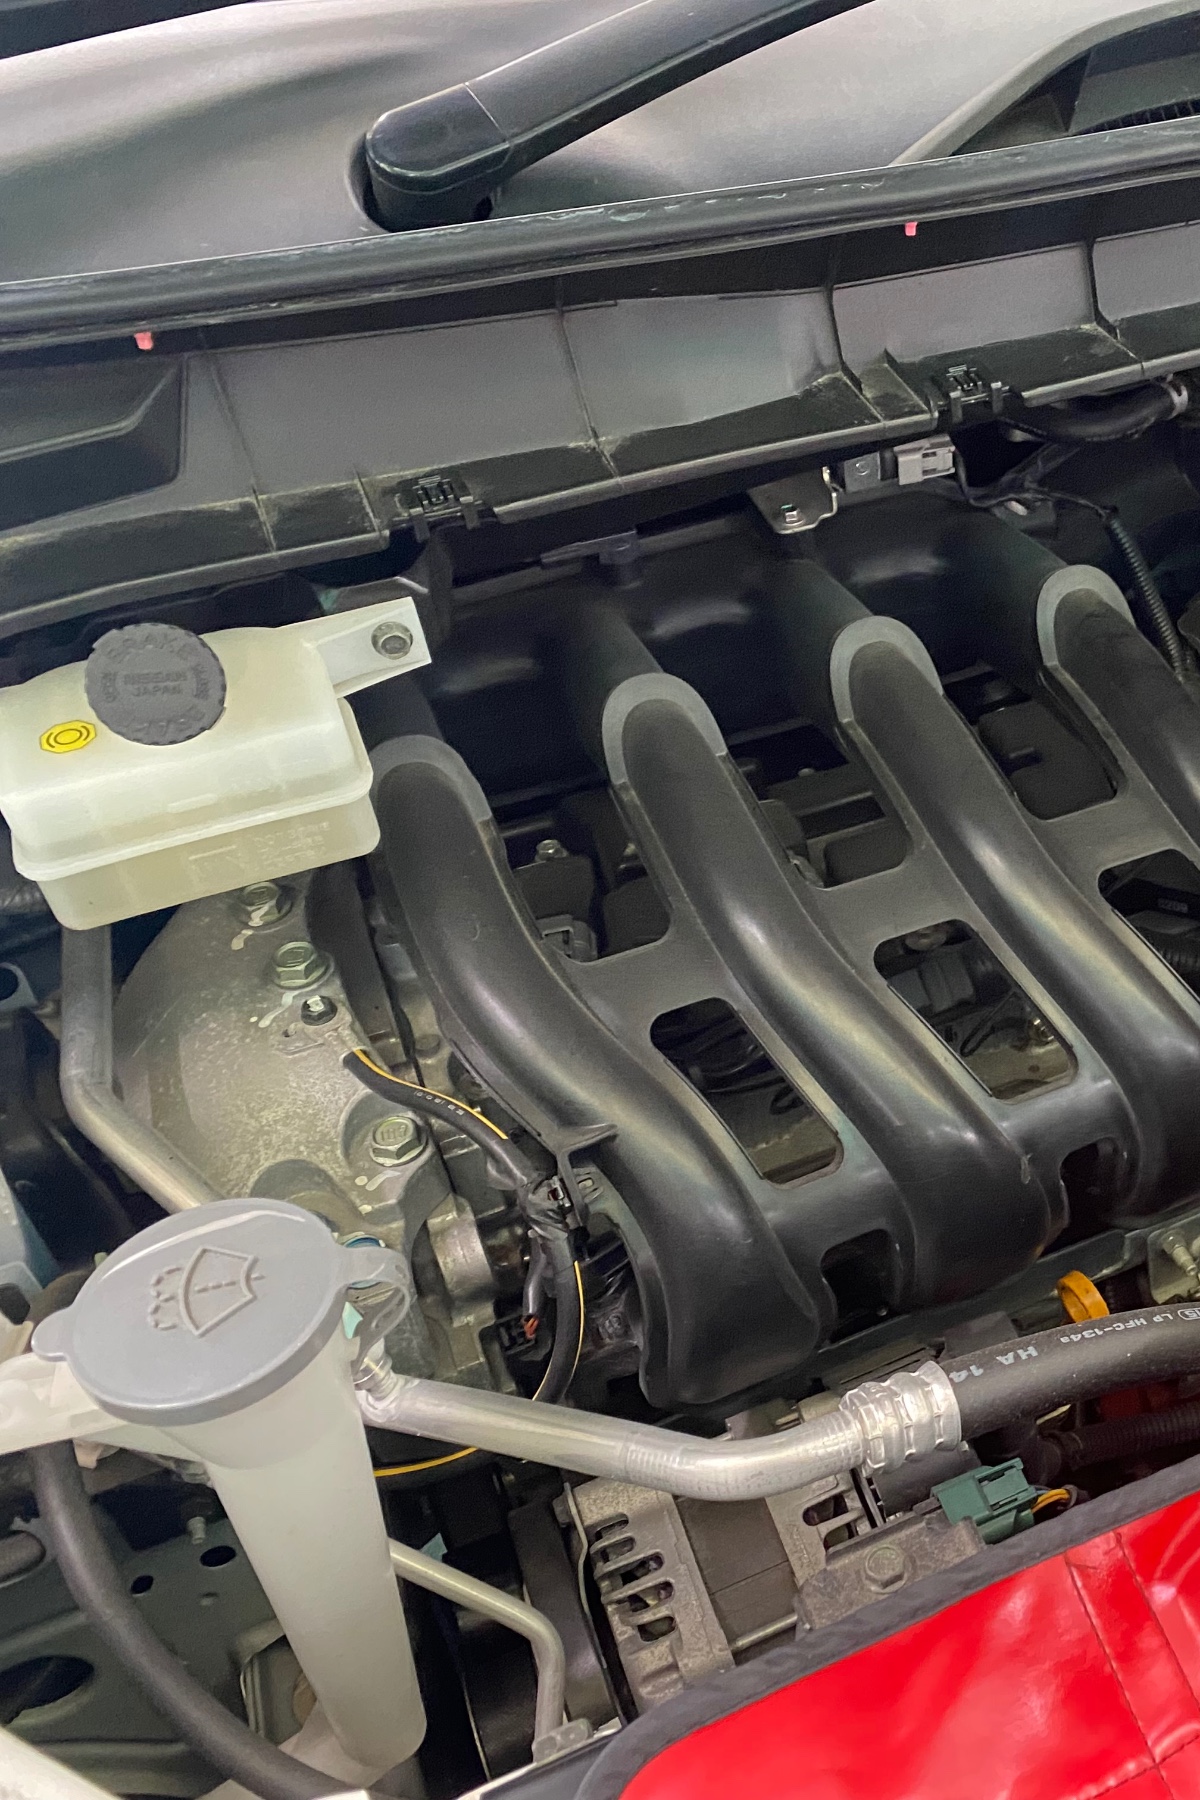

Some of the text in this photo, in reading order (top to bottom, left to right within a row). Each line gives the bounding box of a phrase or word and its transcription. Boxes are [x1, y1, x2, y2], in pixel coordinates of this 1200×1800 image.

[132, 685, 182, 696] JAPAN
[1153, 1312, 1173, 1323] LP
[1059, 1317, 1148, 1343] HFC-134a
[995, 1345, 1038, 1365] HA
[949, 1364, 984, 1383] 14
